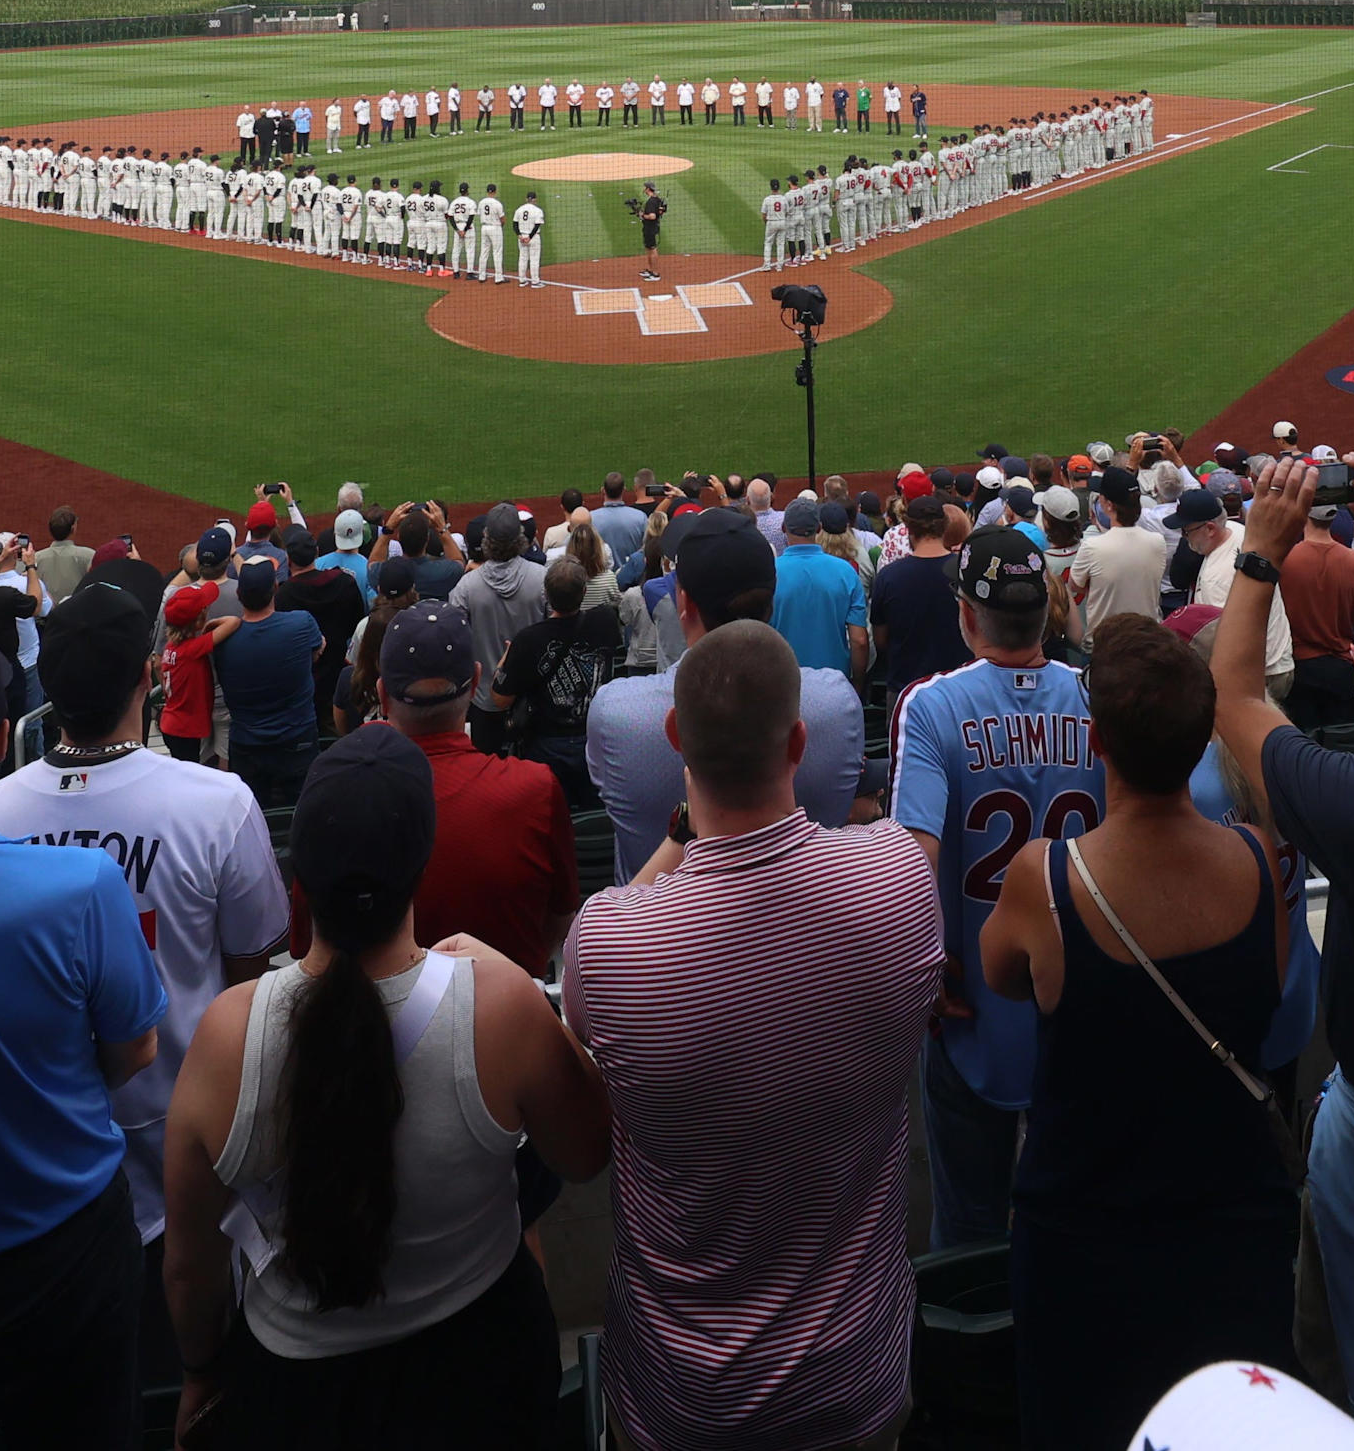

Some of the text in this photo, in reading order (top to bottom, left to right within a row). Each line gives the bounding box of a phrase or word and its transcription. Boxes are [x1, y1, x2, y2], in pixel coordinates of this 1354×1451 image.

[531, 2, 546, 11] 400
[812, 190, 819, 200] 7
[821, 185, 828, 196] 3
[343, 194, 353, 204] 22
[387, 198, 392, 208] 2
[407, 201, 417, 212] 23
[424, 202, 435, 212] 56
[455, 204, 467, 214] 25
[484, 205, 491, 216] 9
[773, 201, 781, 212] 8
[523, 210, 529, 221] 8
[961, 713, 1094, 773] SCHMIDT
[31, 830, 161, 894] XTON
